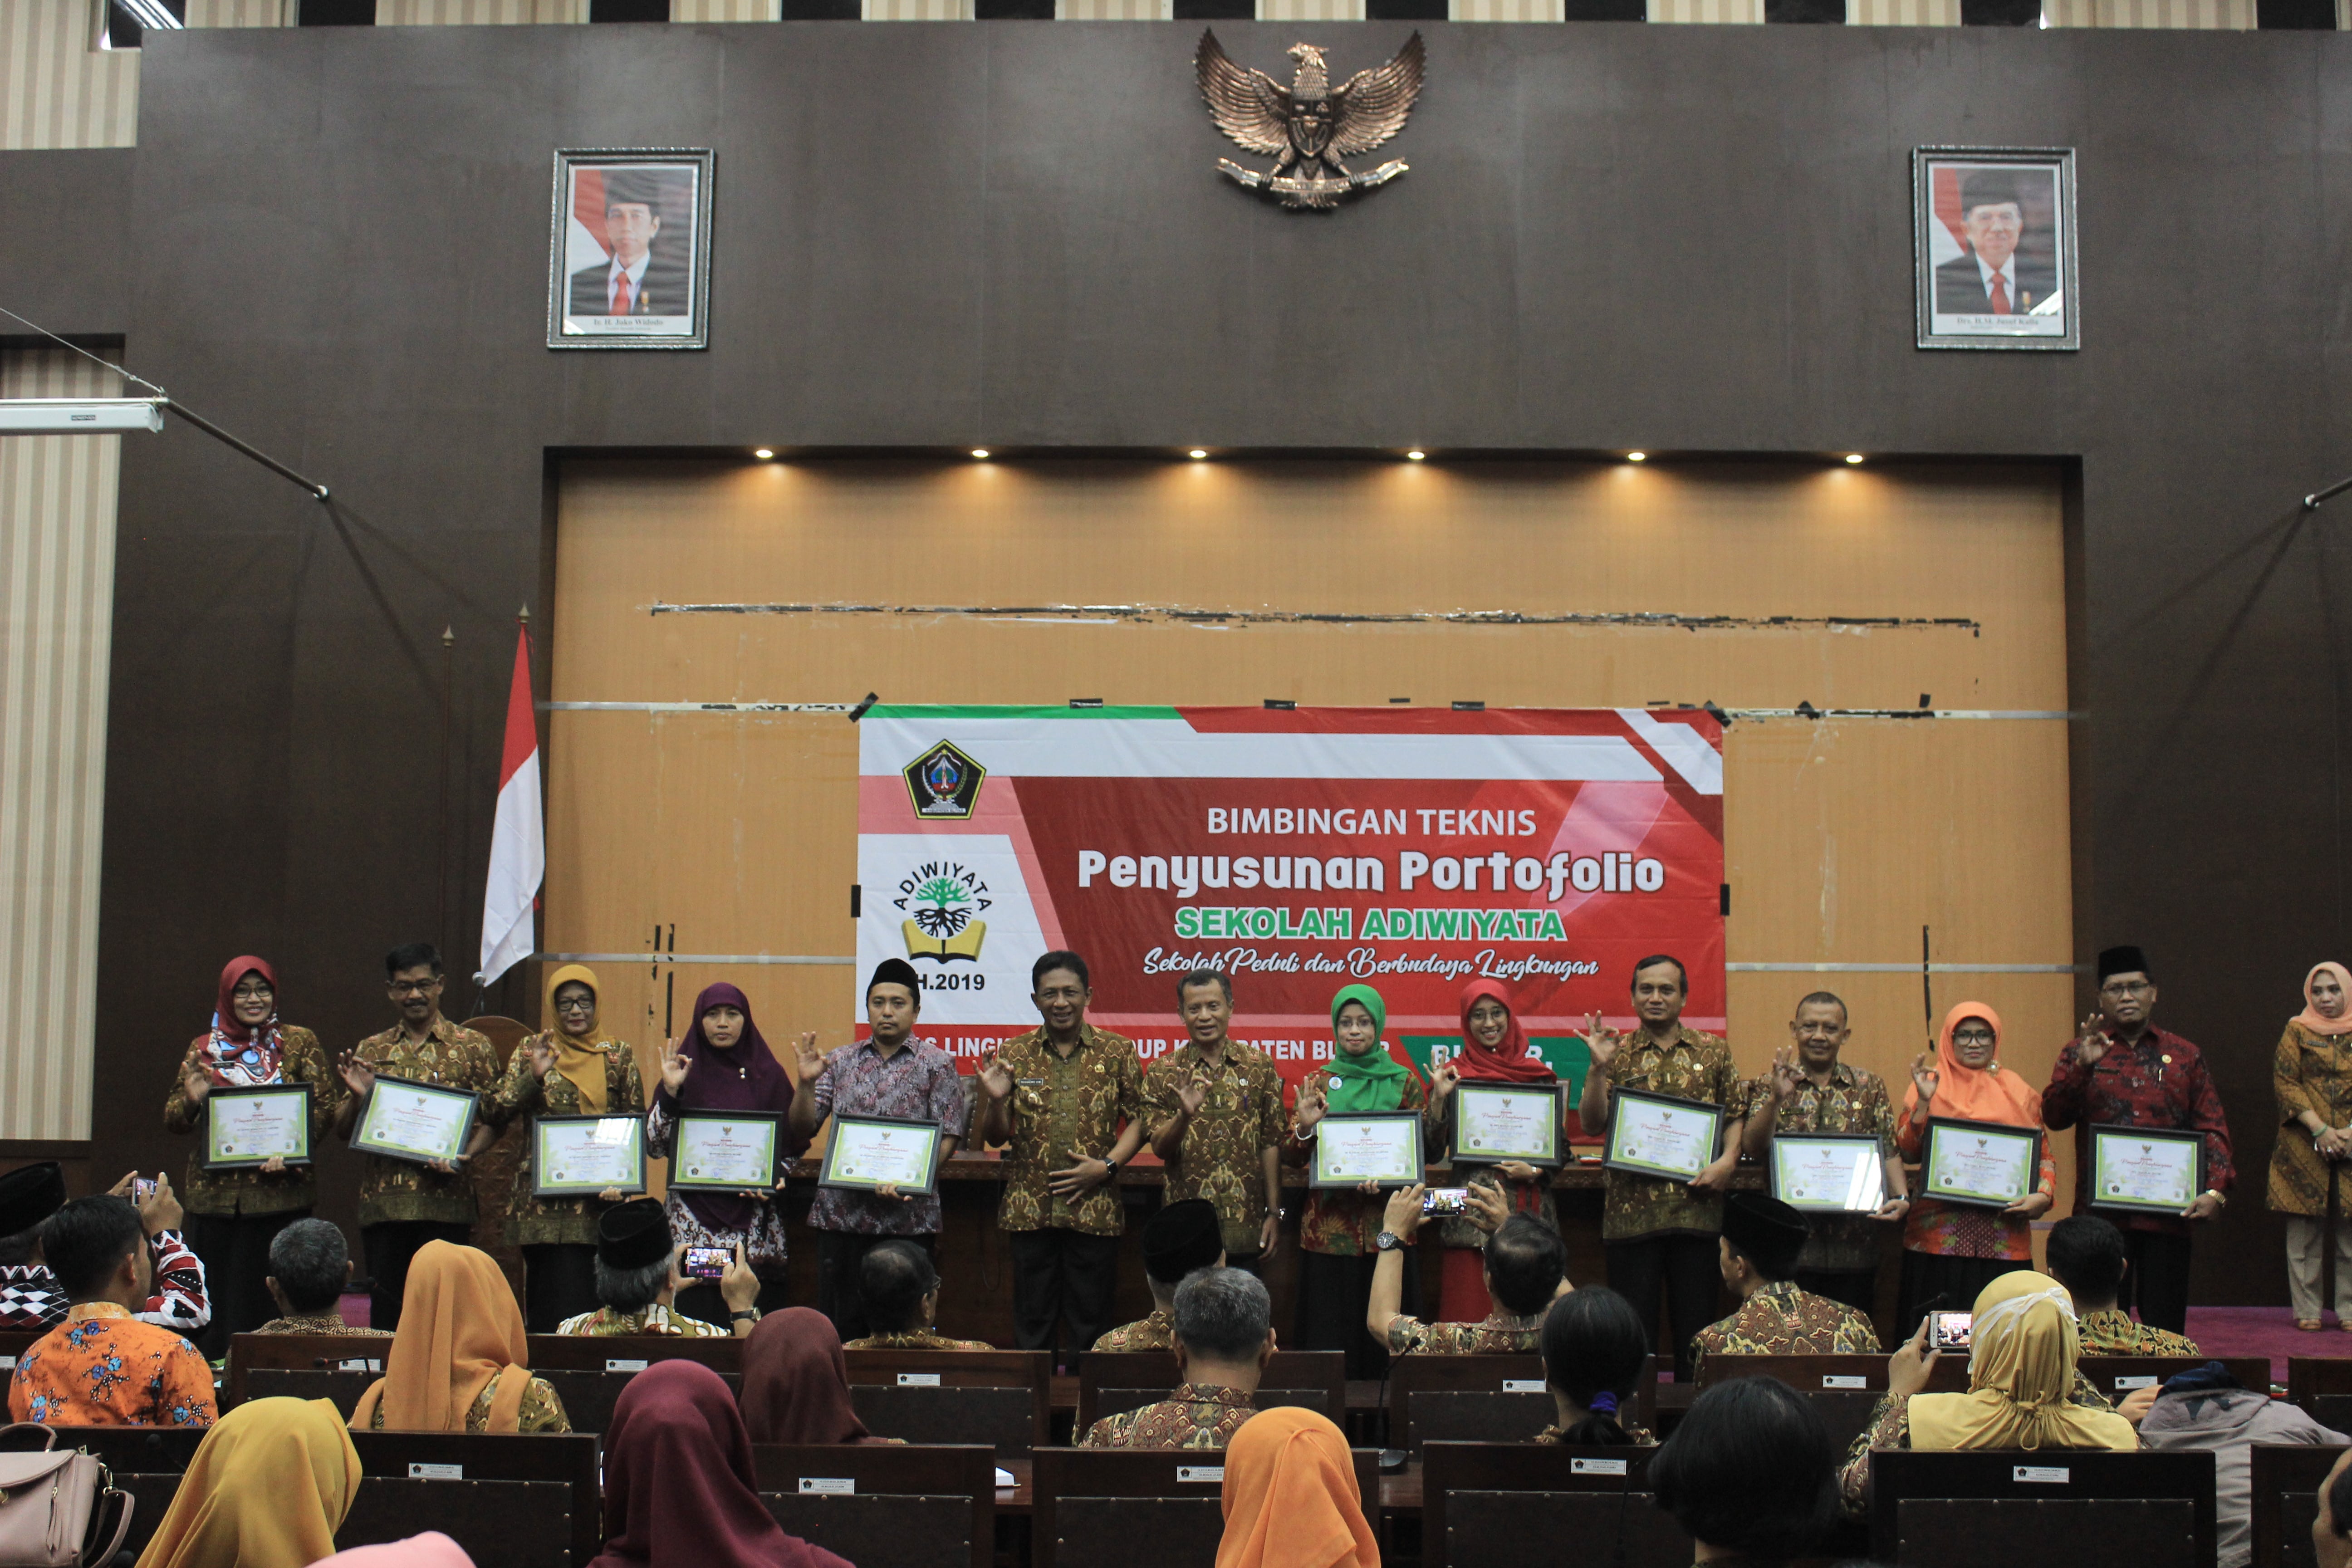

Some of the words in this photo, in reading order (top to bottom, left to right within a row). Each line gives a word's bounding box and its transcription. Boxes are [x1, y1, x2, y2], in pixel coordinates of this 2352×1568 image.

[1208, 808, 1406, 834] BIMBINGAN
[1416, 809, 1537, 836] TEKNIS
[893, 861, 992, 911] ADIWIYATA
[1078, 850, 1384, 898] Penyusunan
[1400, 851, 1664, 902] Portofolio
[1174, 906, 1352, 939] SEKOLAH
[1360, 908, 1568, 941] ADIWIYATA
[1142, 946, 1225, 974] Sekolah
[1224, 946, 1300, 975] Peduli
[1303, 952, 1346, 973] dan
[1347, 947, 1474, 981] Berbudaya
[1474, 948, 1600, 982] Lingkungan
